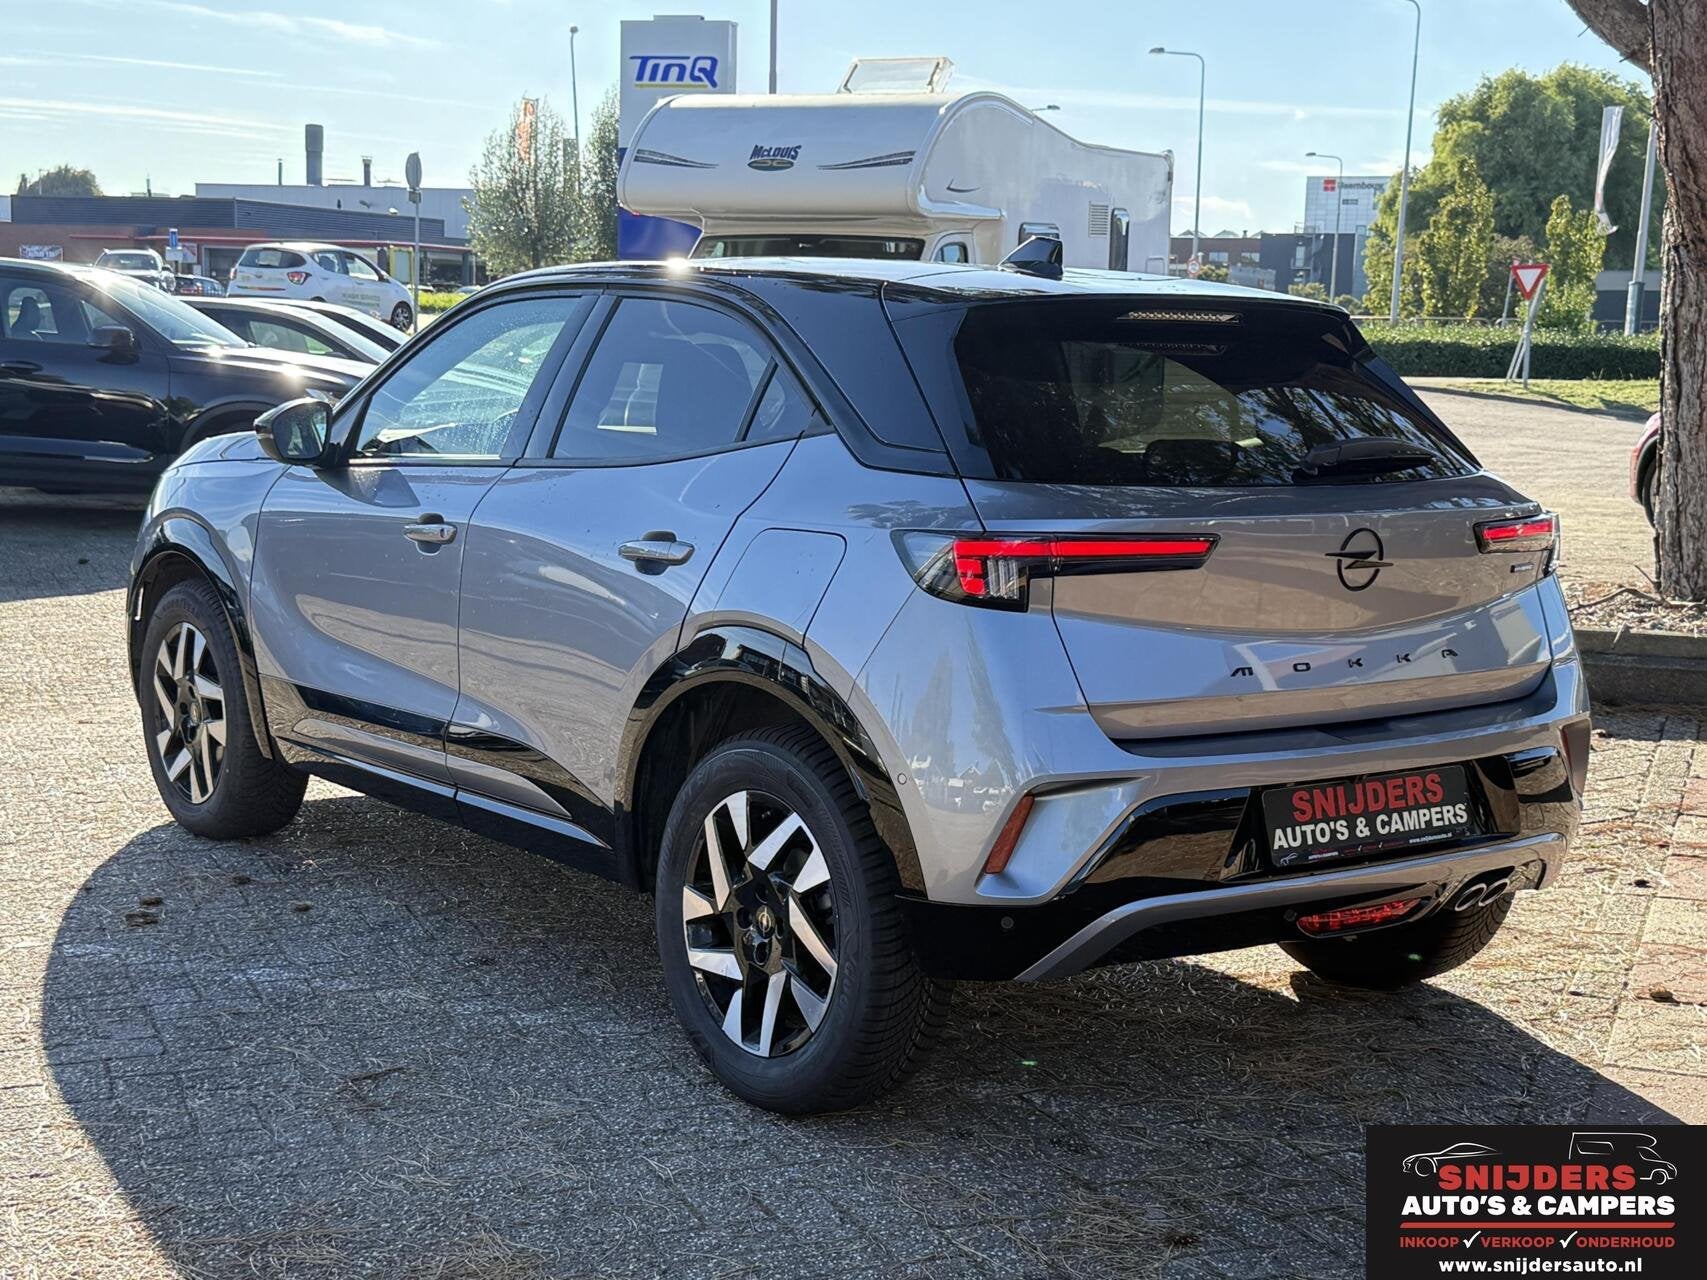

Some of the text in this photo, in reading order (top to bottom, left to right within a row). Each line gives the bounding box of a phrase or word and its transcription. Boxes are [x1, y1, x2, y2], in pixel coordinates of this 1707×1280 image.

[1230, 648, 1458, 678] MOKKA
[1291, 773, 1445, 823] SNIJDERS
[1273, 820, 1349, 850] AUTO'S
[1355, 817, 1371, 838] &
[1375, 804, 1468, 835] CAMPERS
